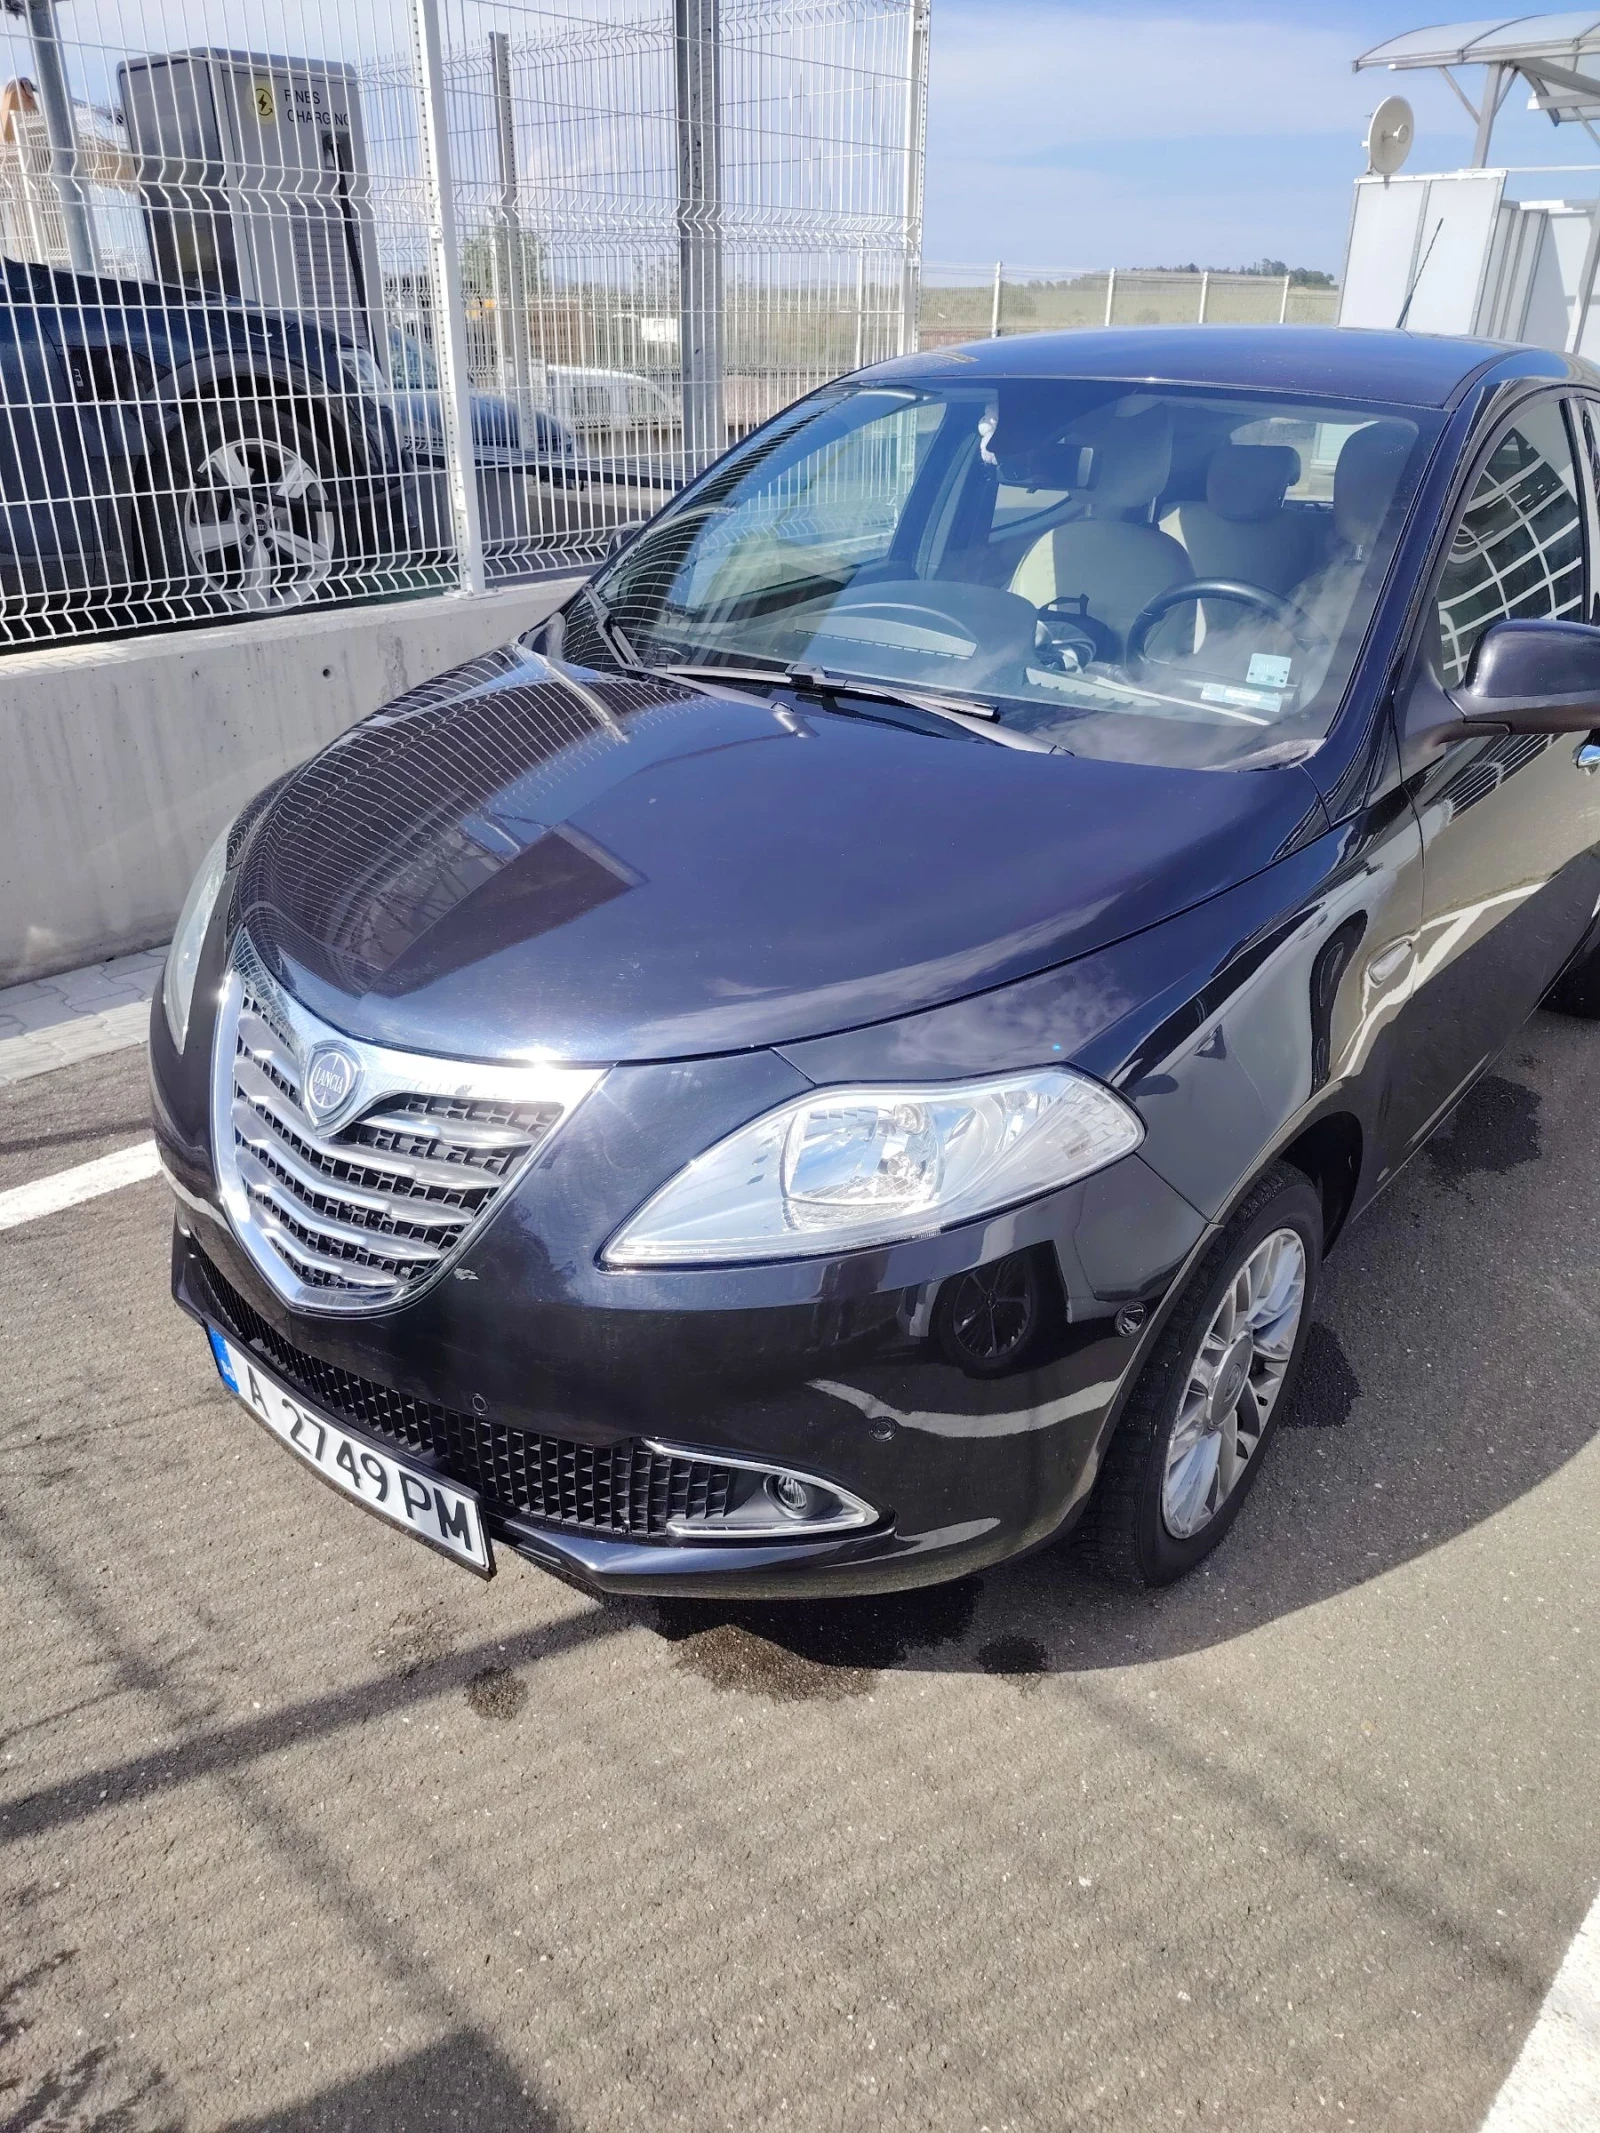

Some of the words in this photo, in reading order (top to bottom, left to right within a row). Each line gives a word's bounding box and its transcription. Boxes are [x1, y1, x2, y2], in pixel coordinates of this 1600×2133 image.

[284, 89, 320, 104] FNES
[313, 1067, 344, 1094] LANCIA
[247, 1364, 270, 1419] A
[281, 1397, 389, 1503] 2749
[398, 1469, 474, 1552] PM
